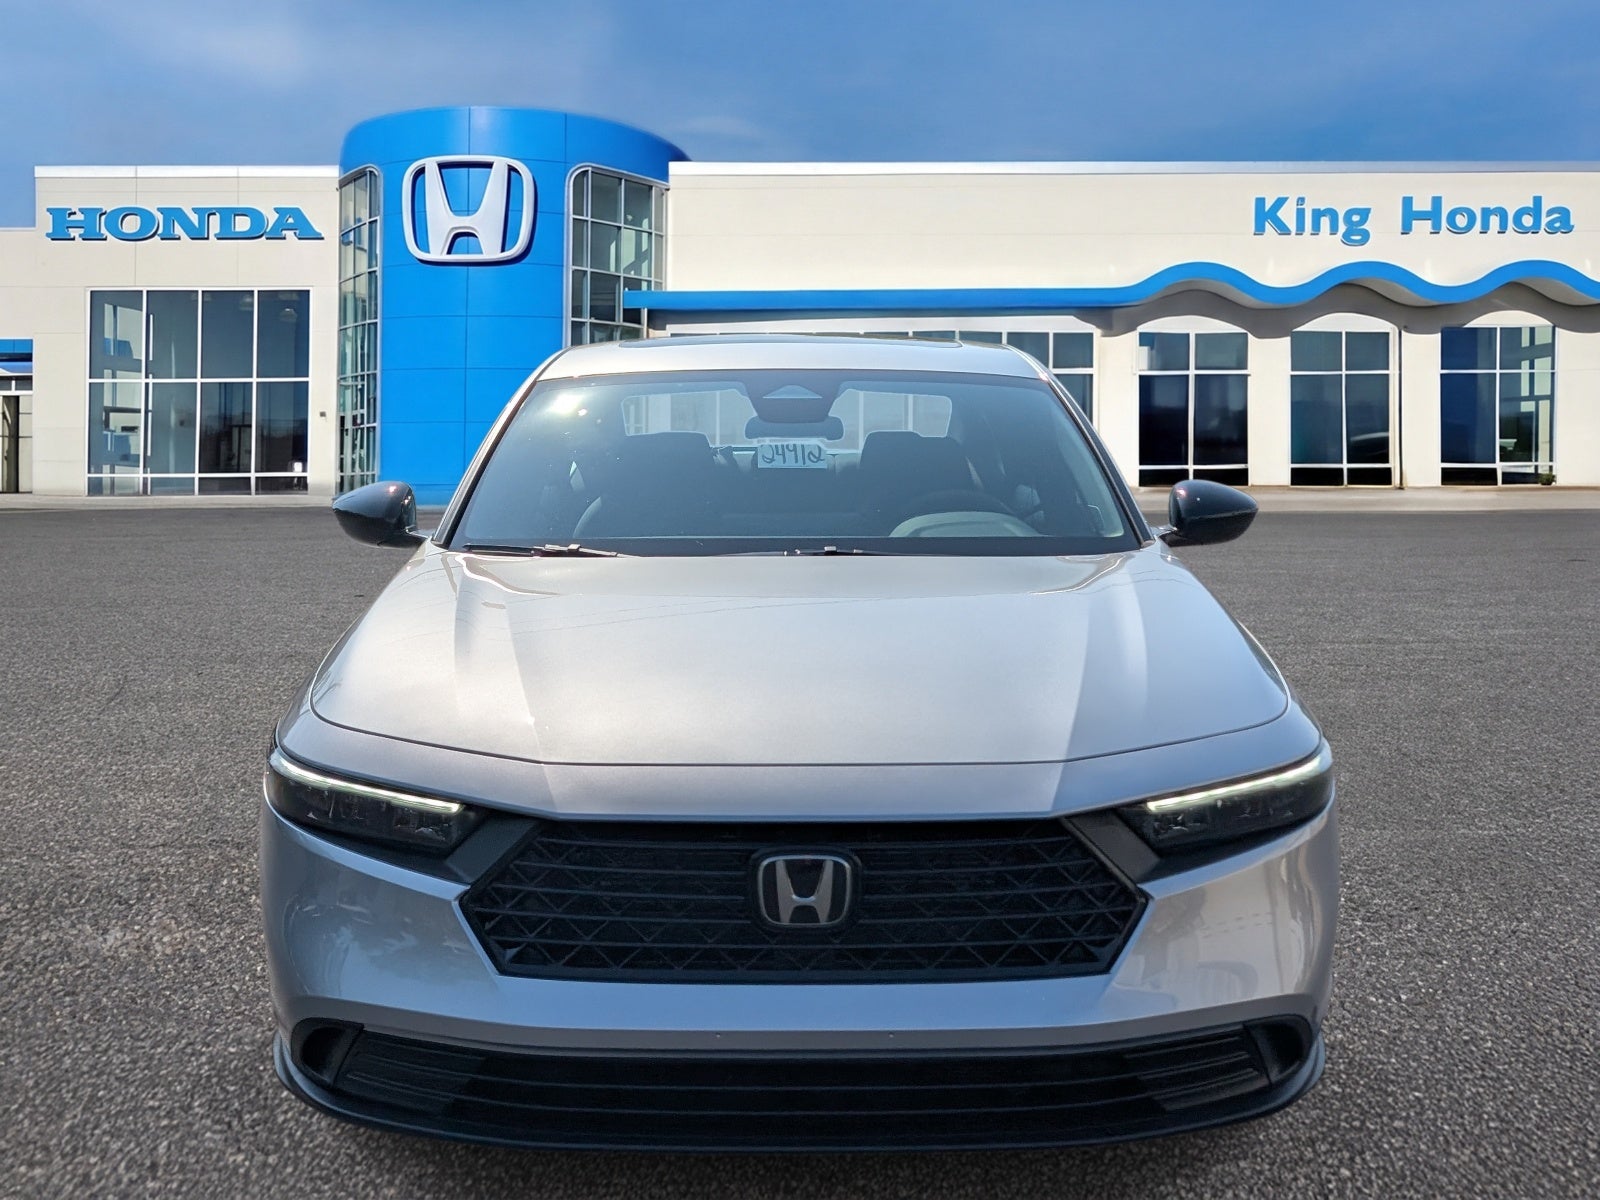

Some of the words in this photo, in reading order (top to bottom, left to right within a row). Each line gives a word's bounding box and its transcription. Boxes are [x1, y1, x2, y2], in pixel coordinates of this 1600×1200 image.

[45, 206, 325, 241] HONDA
[1253, 196, 1372, 246] King
[1401, 195, 1575, 235] Honda
